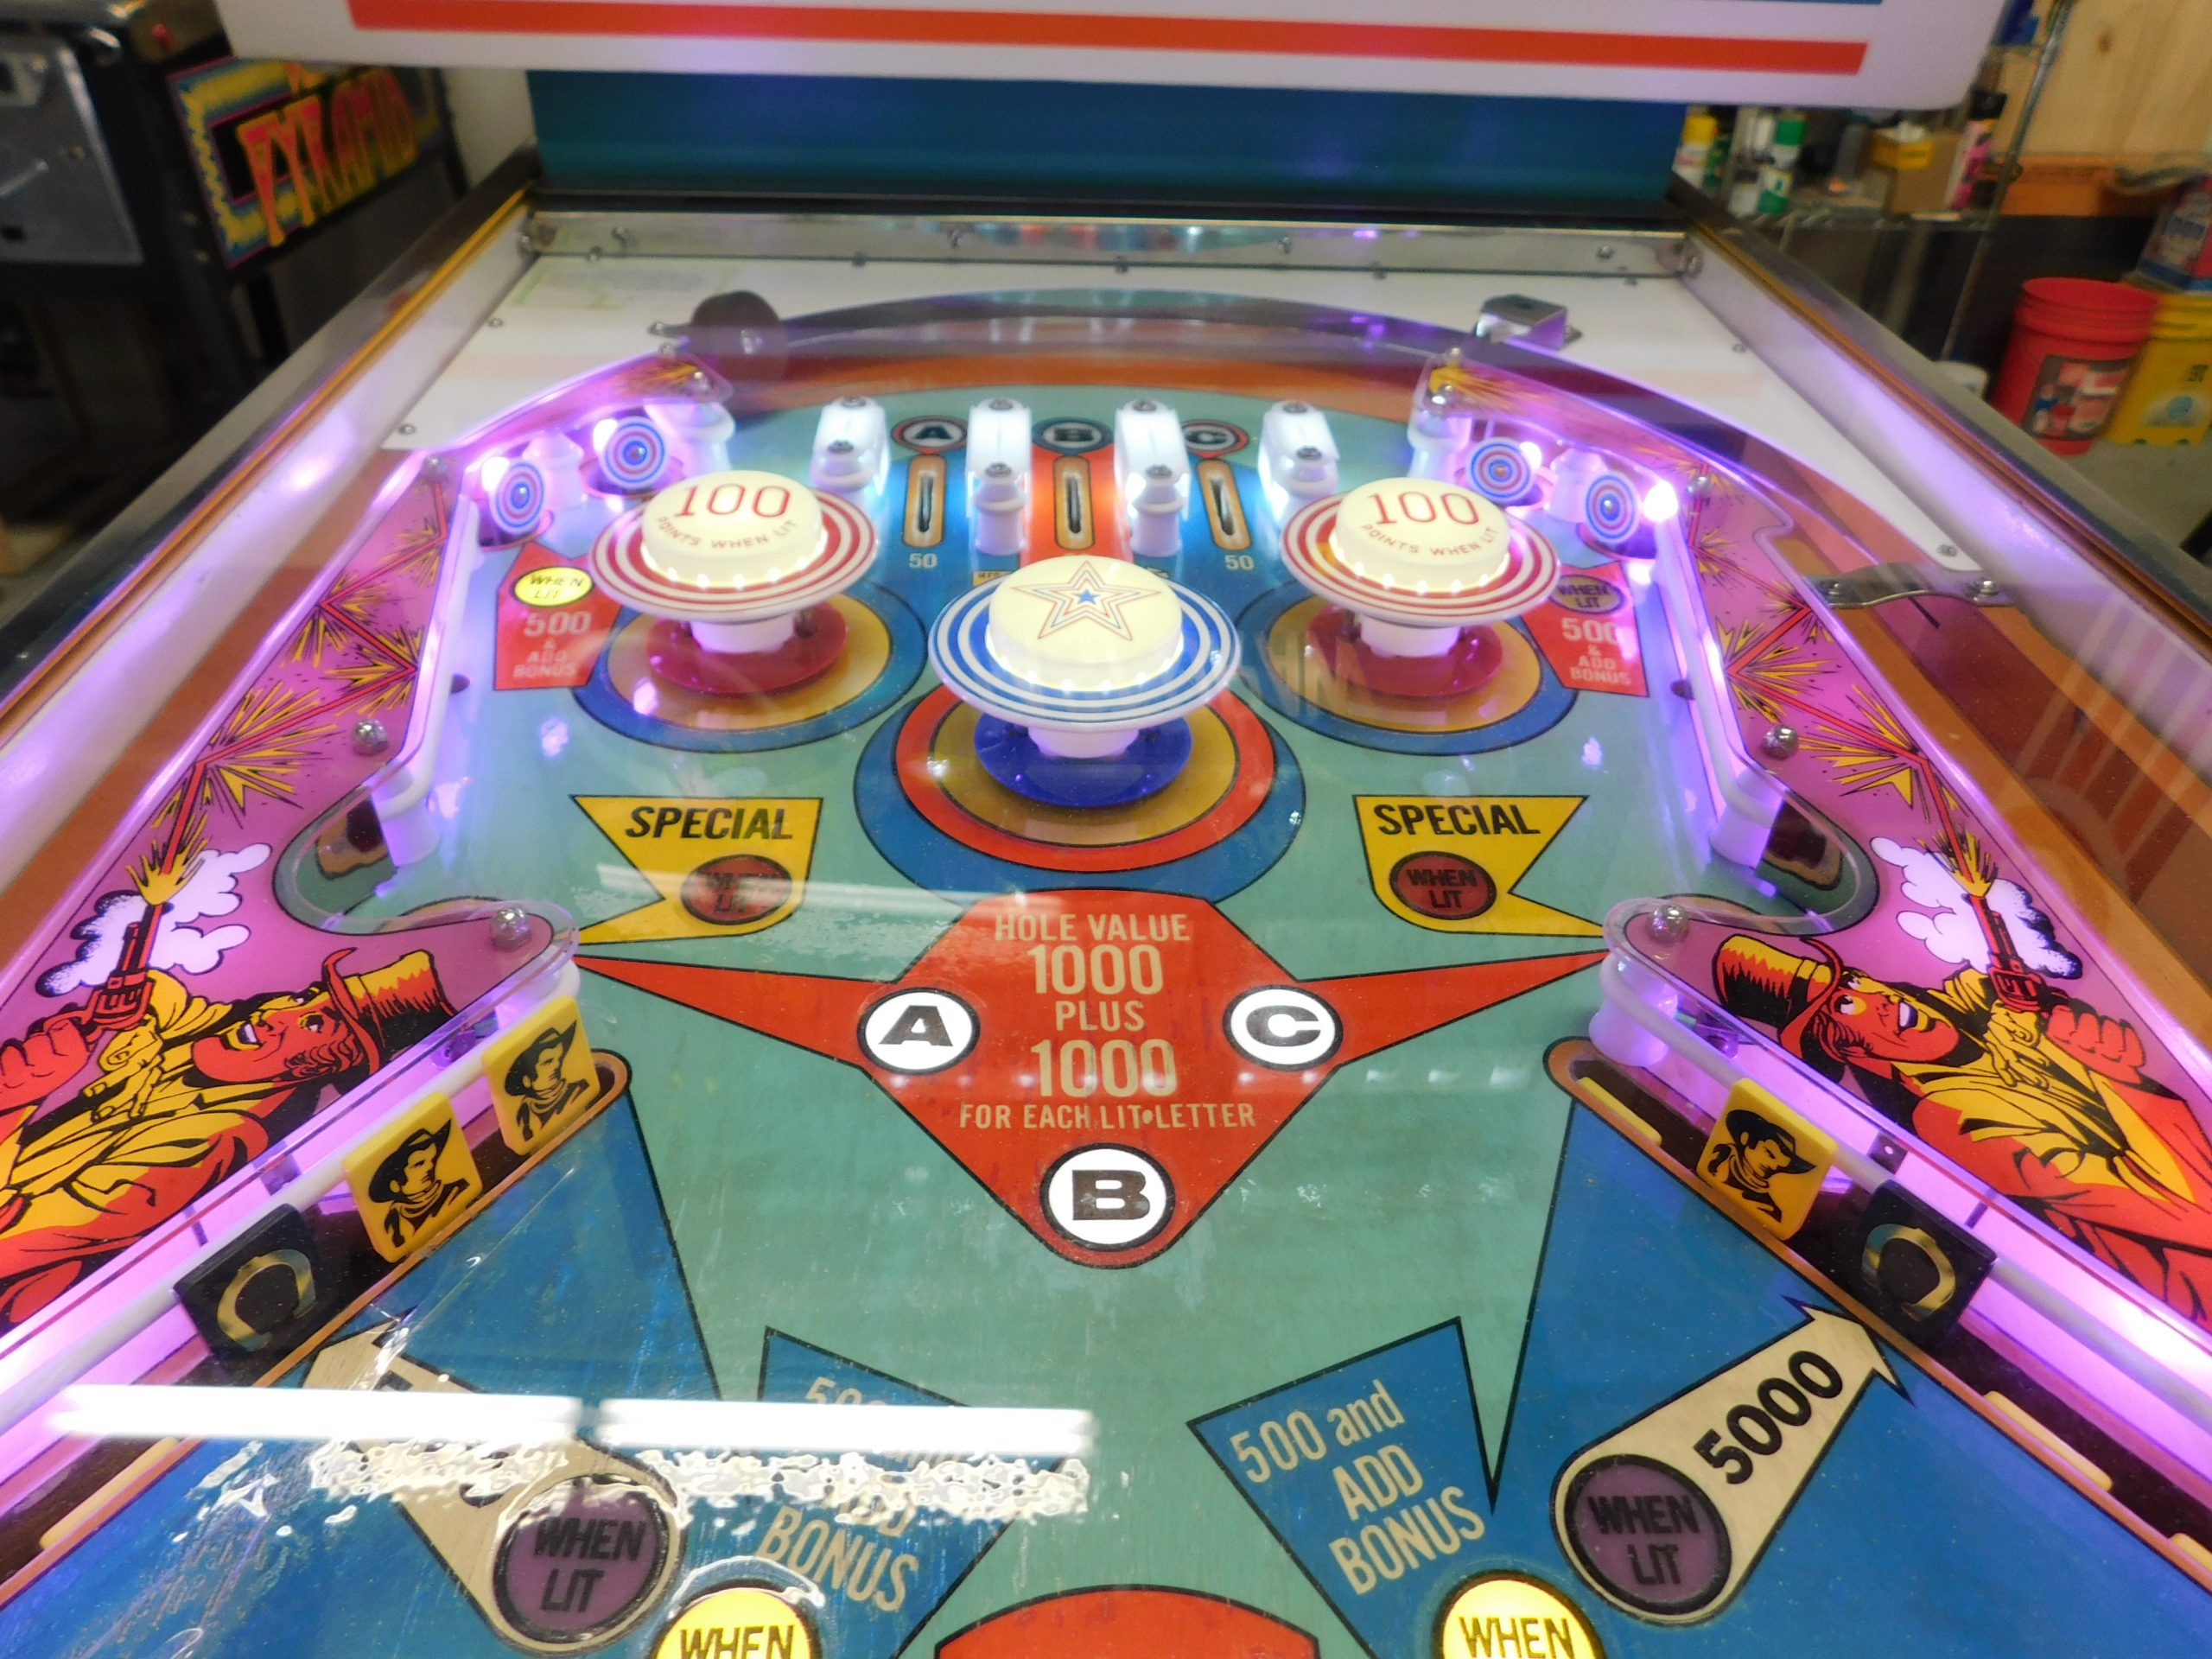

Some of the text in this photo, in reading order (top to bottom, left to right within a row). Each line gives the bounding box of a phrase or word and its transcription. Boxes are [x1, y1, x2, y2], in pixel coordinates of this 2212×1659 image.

[915, 426, 953, 440] A
[674, 482, 792, 518] 100
[1369, 491, 1480, 525] 100
[658, 515, 797, 549] POINTS WHEN LIT
[1360, 524, 1500, 556] POINTS WHEN LIT
[908, 554, 938, 569] 50
[1224, 555, 1255, 570] 50
[530, 574, 584, 587] WHEN
[1557, 584, 1610, 596] WHEN
[1574, 596, 1601, 608] LIT
[523, 610, 592, 638] 500
[1568, 665, 1632, 685] BONUS
[1579, 654, 1618, 671] ADD
[625, 805, 793, 840] SPECIAL
[1373, 804, 1541, 836] SPECIAL
[1406, 868, 1478, 887] WHEN
[1429, 889, 1463, 909] LIT
[995, 913, 1191, 942] HOLE VALUE
[1027, 944, 1164, 995] 1000
[877, 1005, 954, 1047] A
[1055, 1000, 1146, 1032] PLUS
[1245, 1005, 1322, 1048] C
[1030, 1039, 1178, 1098] 1000
[959, 1103, 1012, 1129] FOR
[1023, 1103, 1091, 1129] EACH
[1071, 1168, 1151, 1222] B
[1229, 1378, 1406, 1484] 500 and
[1693, 1350, 1844, 1485] 5000
[1332, 1444, 1424, 1522] ADD
[1586, 1495, 1701, 1535] WHEN
[532, 1517, 647, 1562] WHEN
[1328, 1485, 1485, 1596] BONUS
[755, 1505, 919, 1612] BONUS
[1627, 1543, 1683, 1586] LIT
[540, 1568, 605, 1612] LIT
[680, 1624, 795, 1659] WHEN
[1458, 1616, 1575, 1659] WHEN
